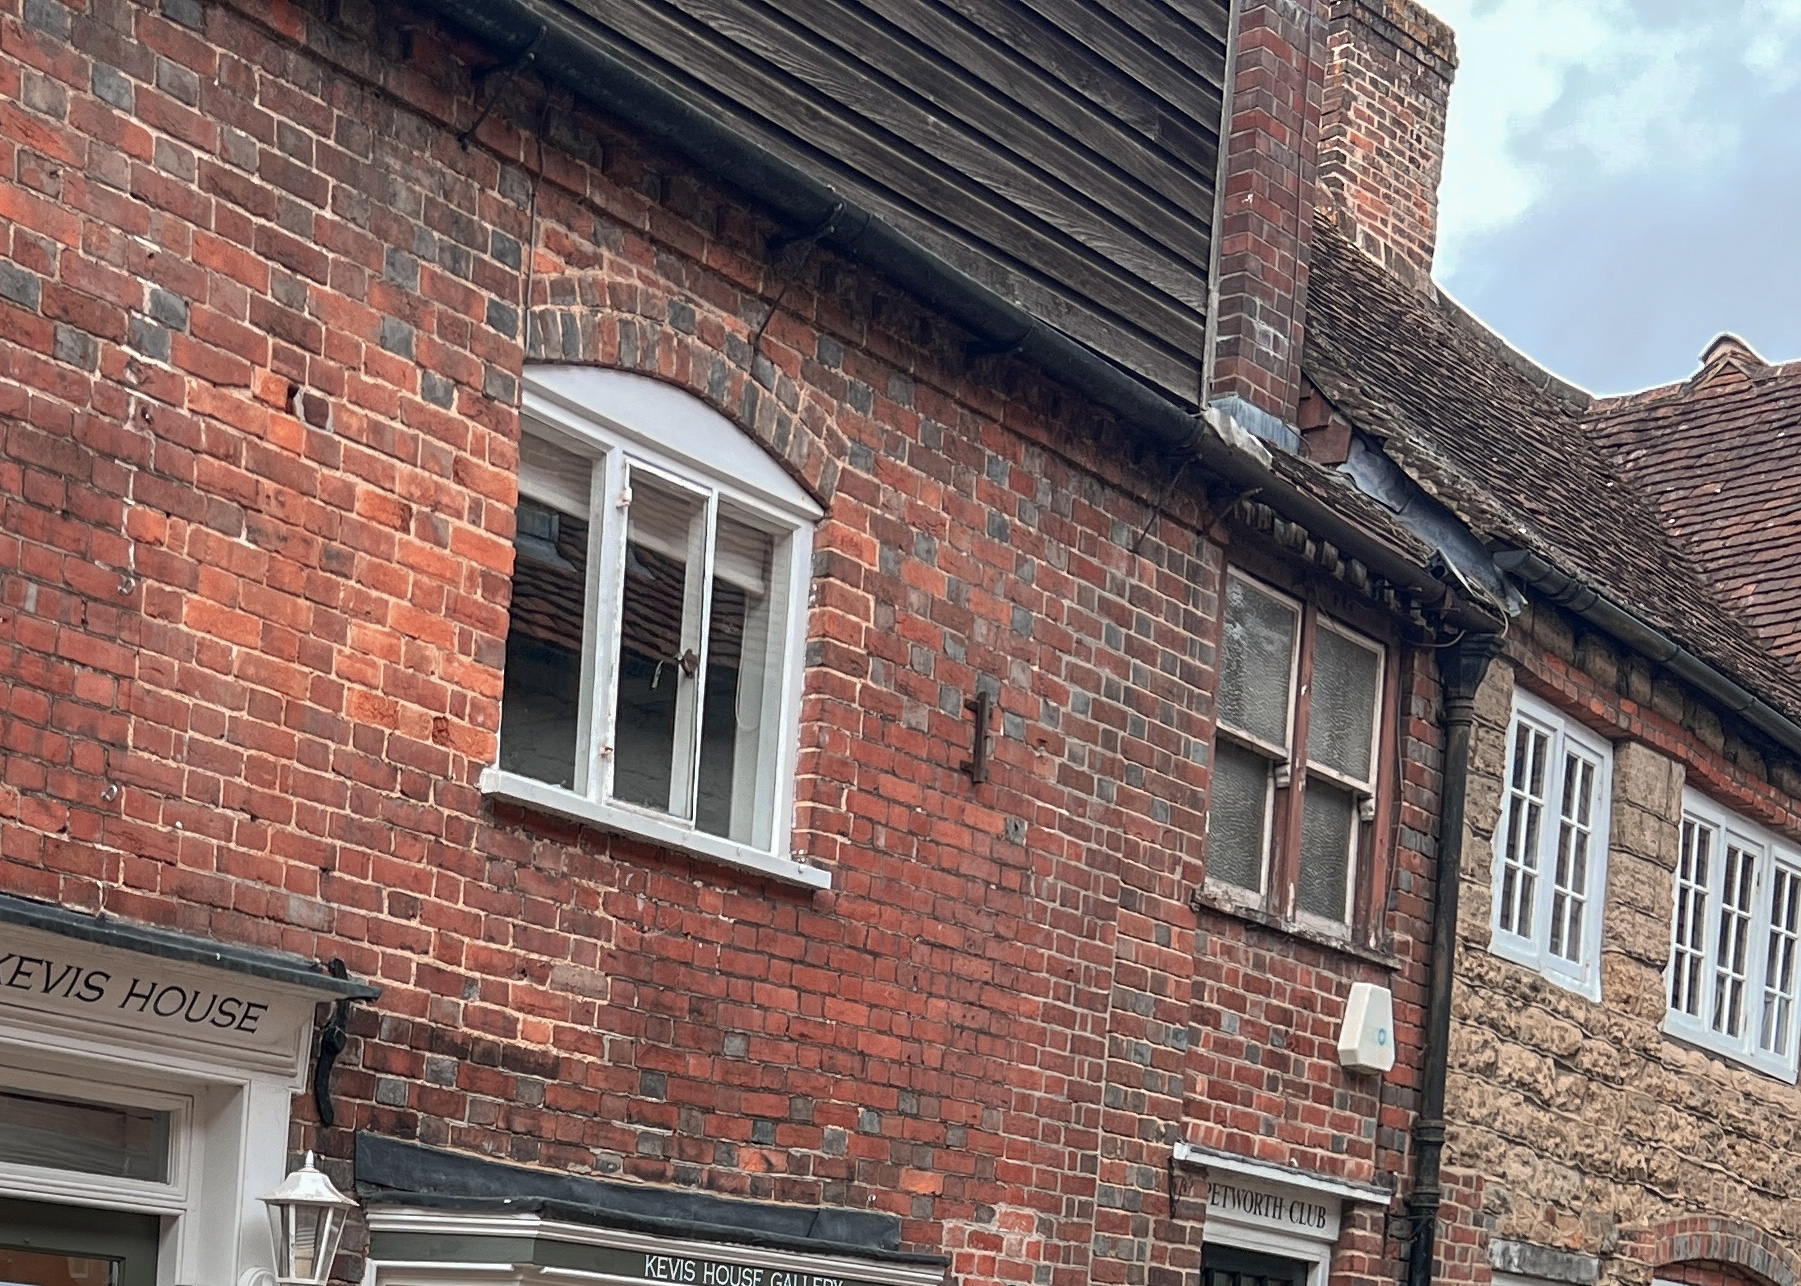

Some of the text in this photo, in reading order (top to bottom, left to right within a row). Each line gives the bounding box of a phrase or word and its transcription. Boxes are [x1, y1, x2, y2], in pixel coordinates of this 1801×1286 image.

[118, 978, 270, 1034] HOUSE
[1289, 1200, 1327, 1229] CLUB
[644, 1254, 696, 1282] KEVIS
